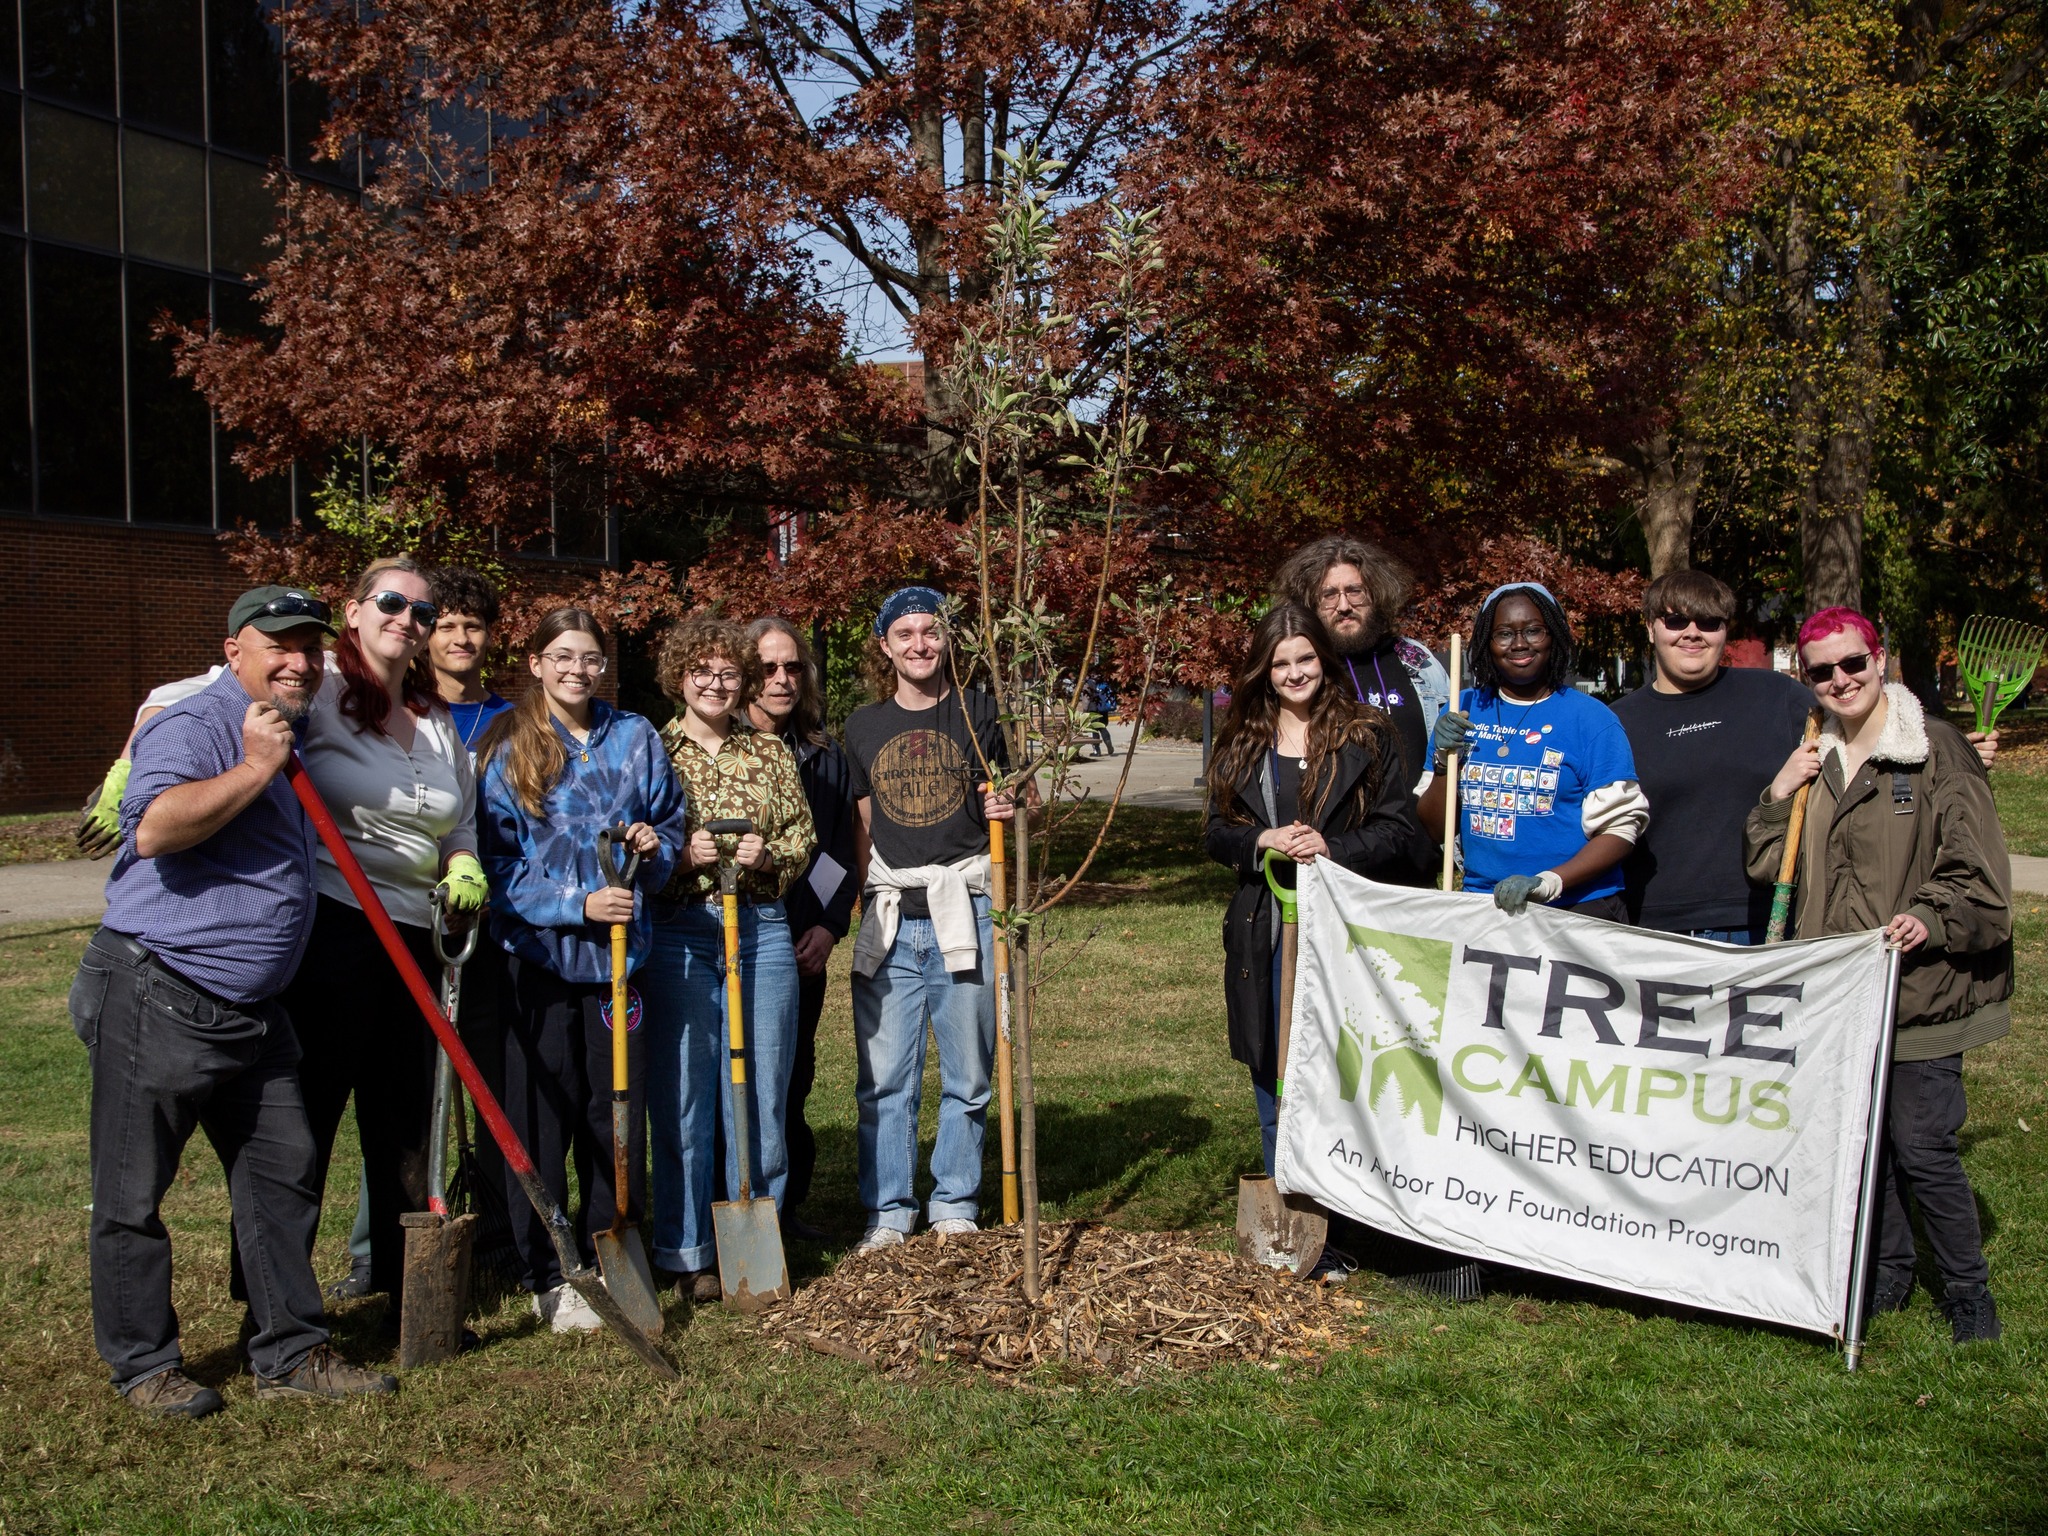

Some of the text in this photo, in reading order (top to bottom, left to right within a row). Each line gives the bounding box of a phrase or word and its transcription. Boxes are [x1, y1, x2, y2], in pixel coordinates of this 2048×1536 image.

[779, 525, 788, 562] HERE
[1518, 728, 1531, 736] of
[900, 781, 940, 799] ALE
[1462, 944, 1805, 1067] TREE
[1451, 1043, 1792, 1131] CAMPUS
[1455, 1115, 1789, 1196] HIGHER EDUCATION
[1327, 1137, 1780, 1259] An Arbor Day Foundation Program
